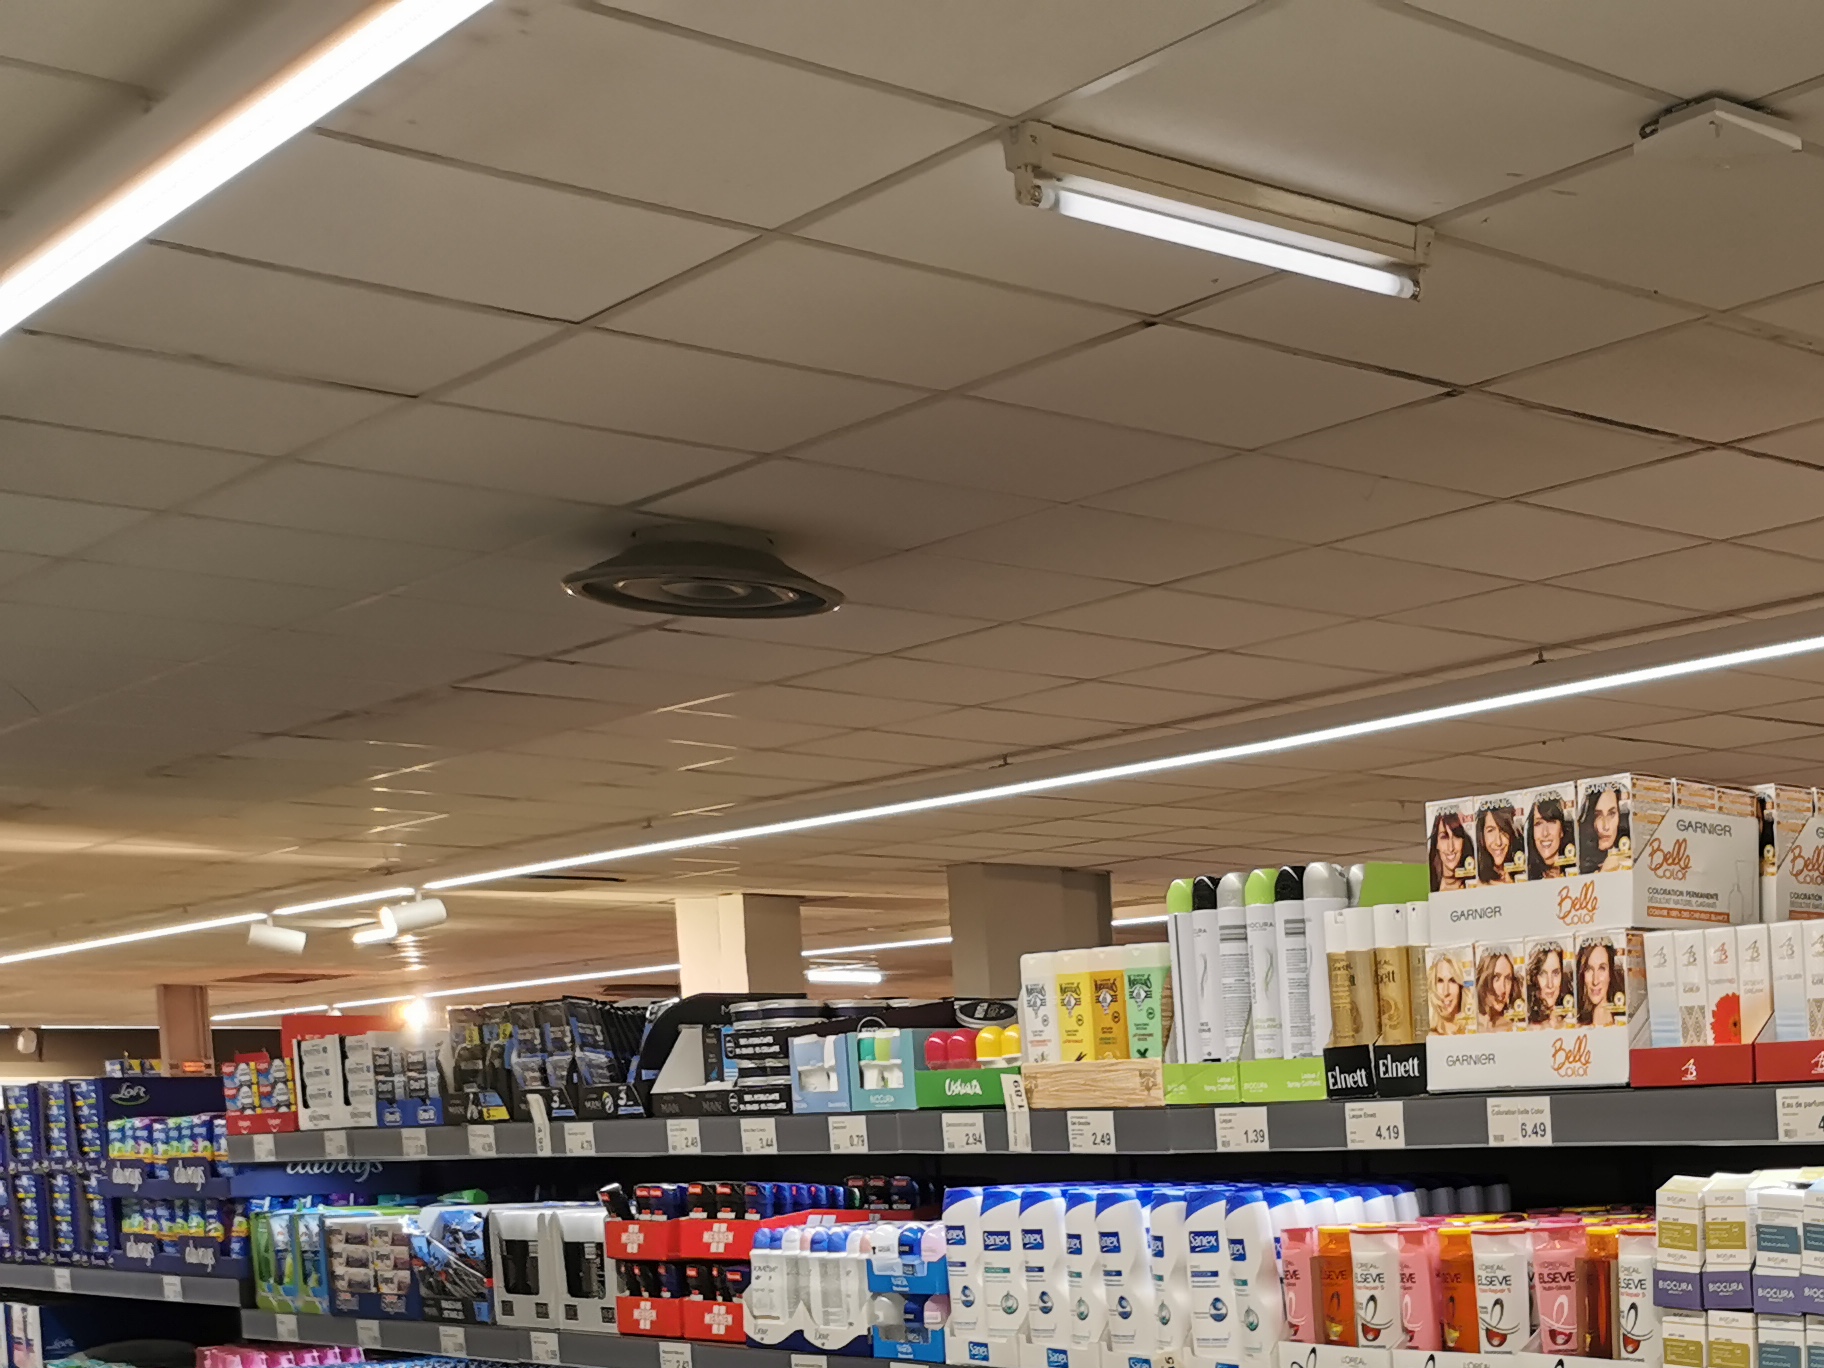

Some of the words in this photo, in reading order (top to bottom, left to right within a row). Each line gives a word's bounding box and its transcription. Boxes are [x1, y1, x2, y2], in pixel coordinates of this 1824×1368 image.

[1676, 818, 1732, 837] GARNIER
[1648, 837, 1693, 872] Belle
[1556, 880, 1598, 916] Belle
[1450, 906, 1502, 922] GARNIER
[1379, 1056, 1421, 1079] Elnett
[1244, 1129, 1265, 1144] 1.39
[1375, 1125, 1399, 1140] 4.19
[1520, 1121, 1546, 1138] 6.49
[1092, 1133, 1111, 1146] 2.49
[1190, 1229, 1218, 1251] Sanex
